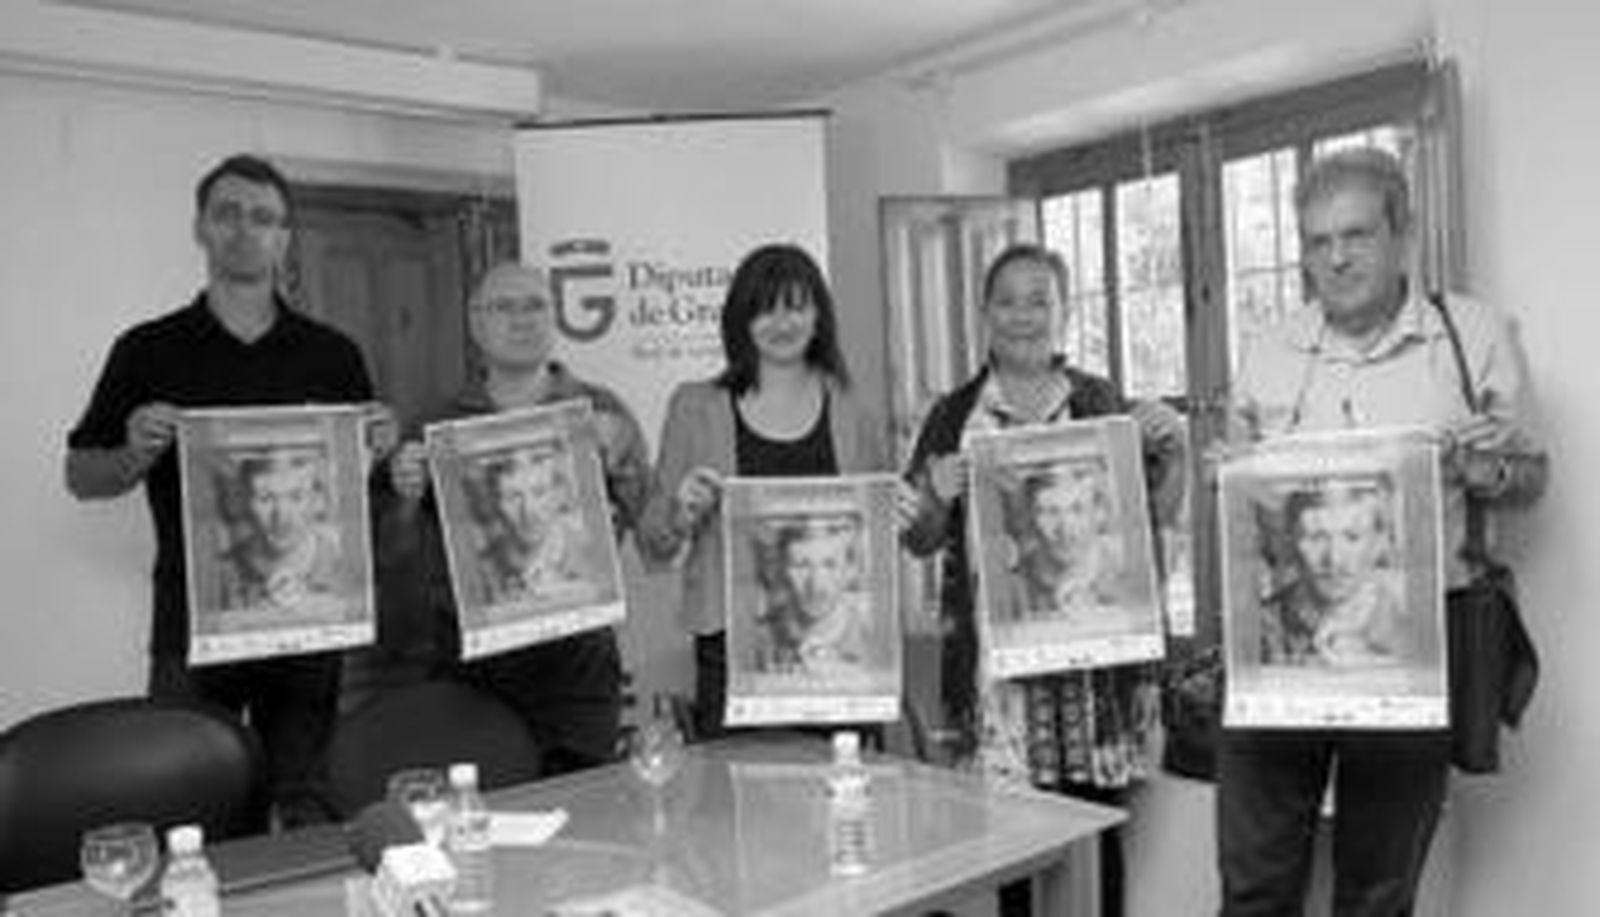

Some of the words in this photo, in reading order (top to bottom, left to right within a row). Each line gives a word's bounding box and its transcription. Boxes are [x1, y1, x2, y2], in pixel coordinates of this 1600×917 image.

[627, 261, 731, 294] Diputa
[629, 296, 664, 326] de
[669, 293, 722, 326] Gra
